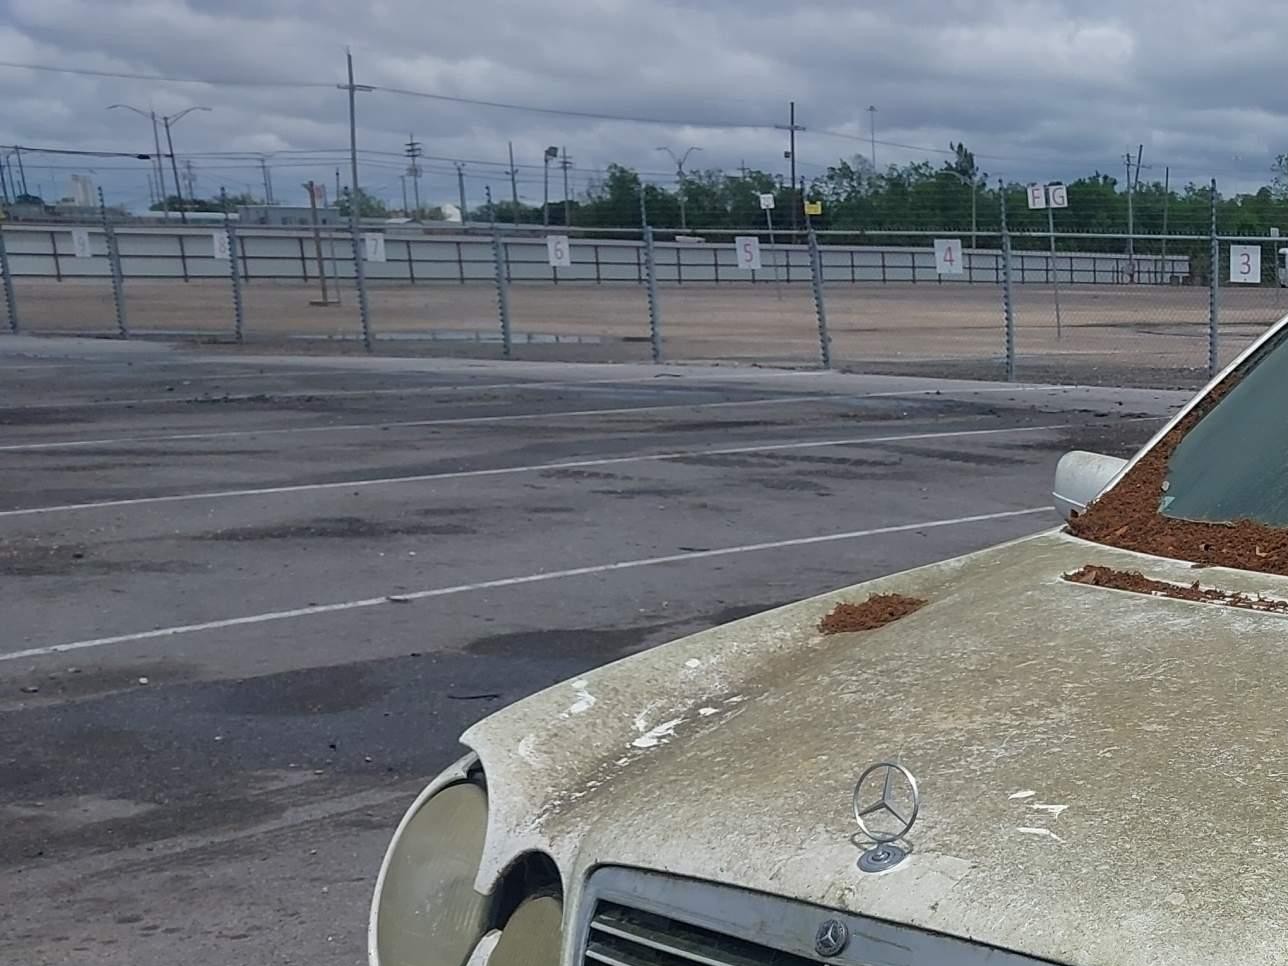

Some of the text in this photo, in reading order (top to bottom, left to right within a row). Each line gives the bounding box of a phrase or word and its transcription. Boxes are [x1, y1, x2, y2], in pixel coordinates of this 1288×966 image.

[1031, 188, 1041, 207] F
[1052, 187, 1065, 206] G
[554, 241, 564, 260] 6
[943, 246, 955, 267] 4
[1240, 253, 1251, 275] 3
